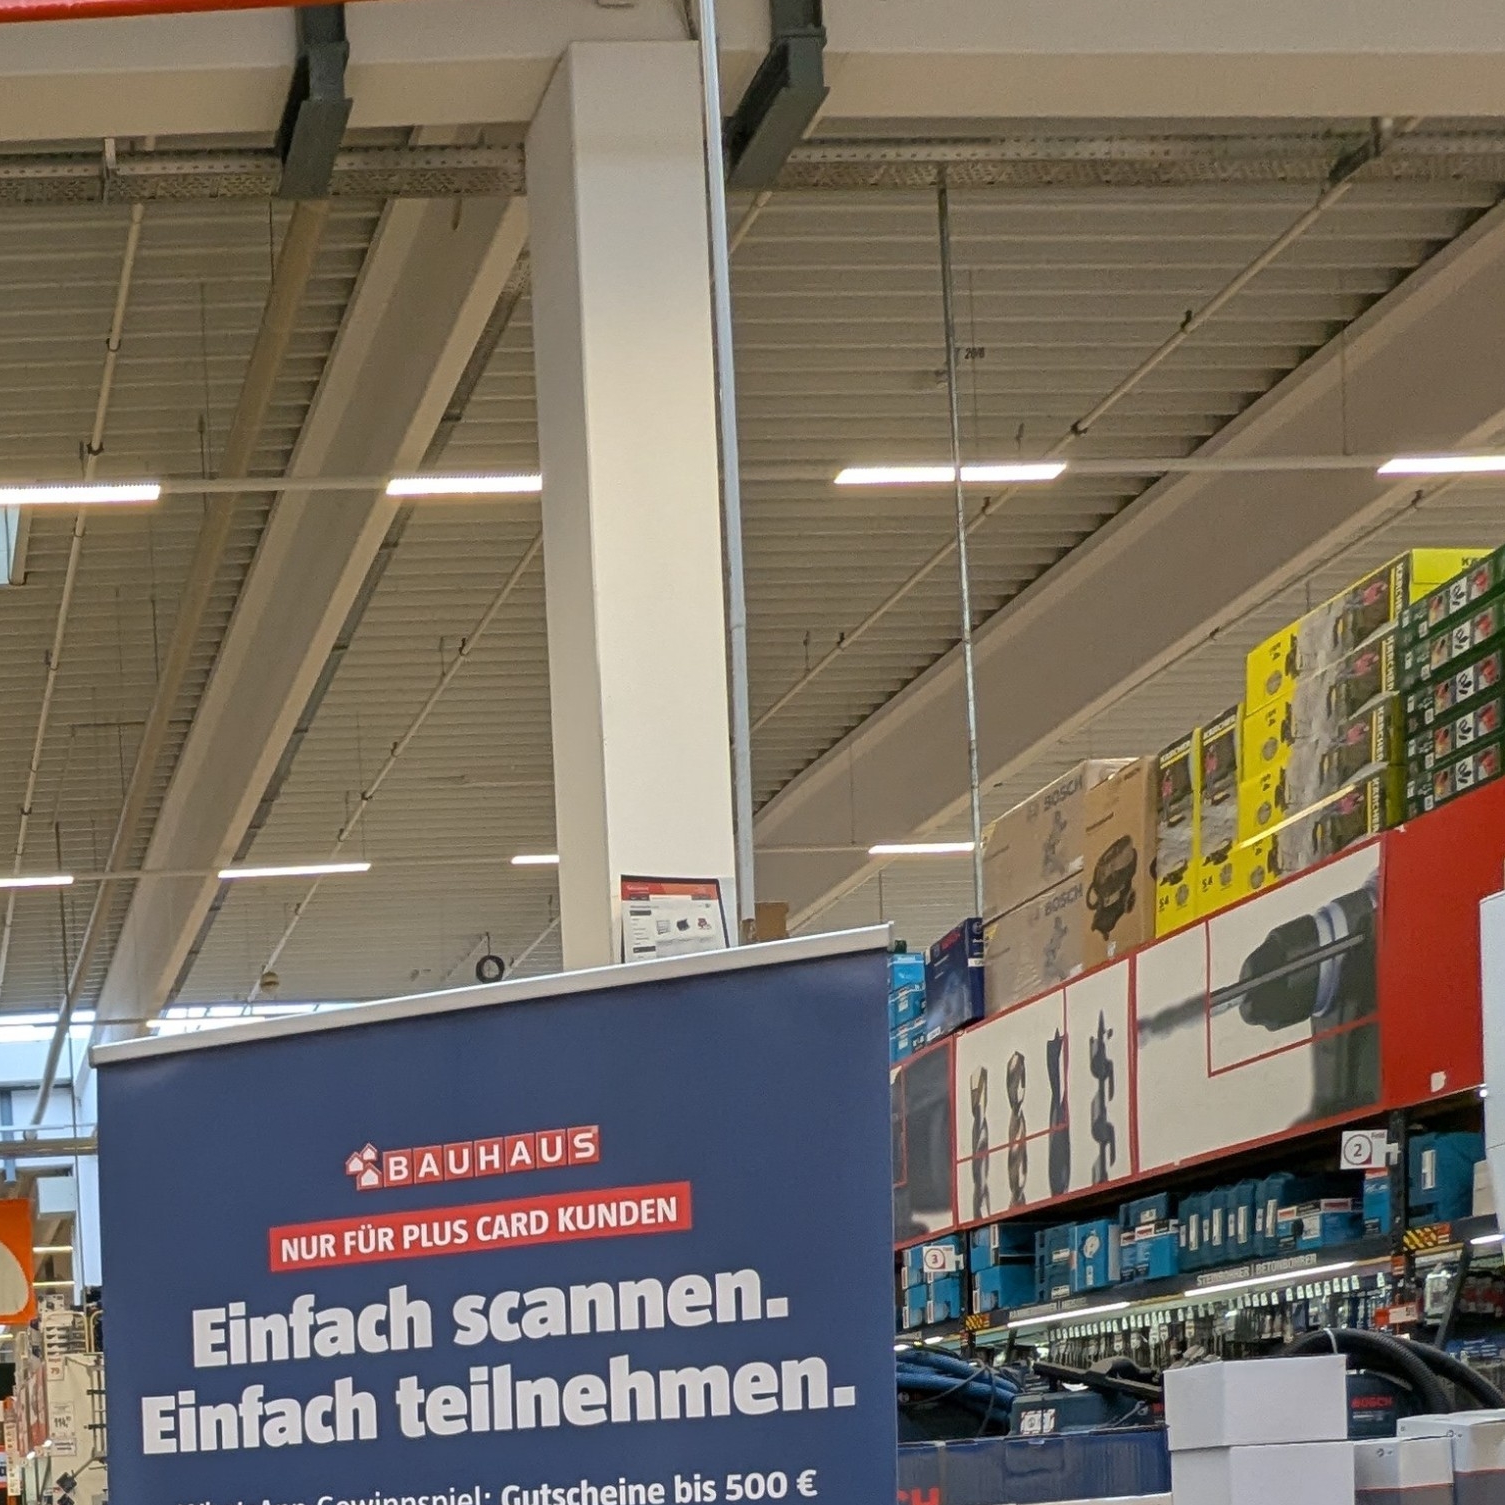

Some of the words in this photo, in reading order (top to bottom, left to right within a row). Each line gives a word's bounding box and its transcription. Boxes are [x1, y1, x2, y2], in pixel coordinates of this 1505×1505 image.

[387, 1128, 598, 1183] BAUHAUS
[1354, 1143, 1363, 1157] 2
[280, 1231, 337, 1264] NUR
[343, 1221, 396, 1256] FÜR
[403, 1218, 469, 1252] PLUS
[476, 1208, 550, 1243] CARD
[557, 1195, 679, 1234] KUNDEN
[931, 1254, 939, 1264] 3
[192, 1284, 433, 1368] Einfach
[453, 1264, 790, 1346] scannen.
[141, 1375, 378, 1455] Einfach
[395, 1352, 857, 1440] teilnehmen.
[675, 1472, 717, 1503] bis
[726, 1470, 789, 1501] 500
[797, 1468, 818, 1497] €
